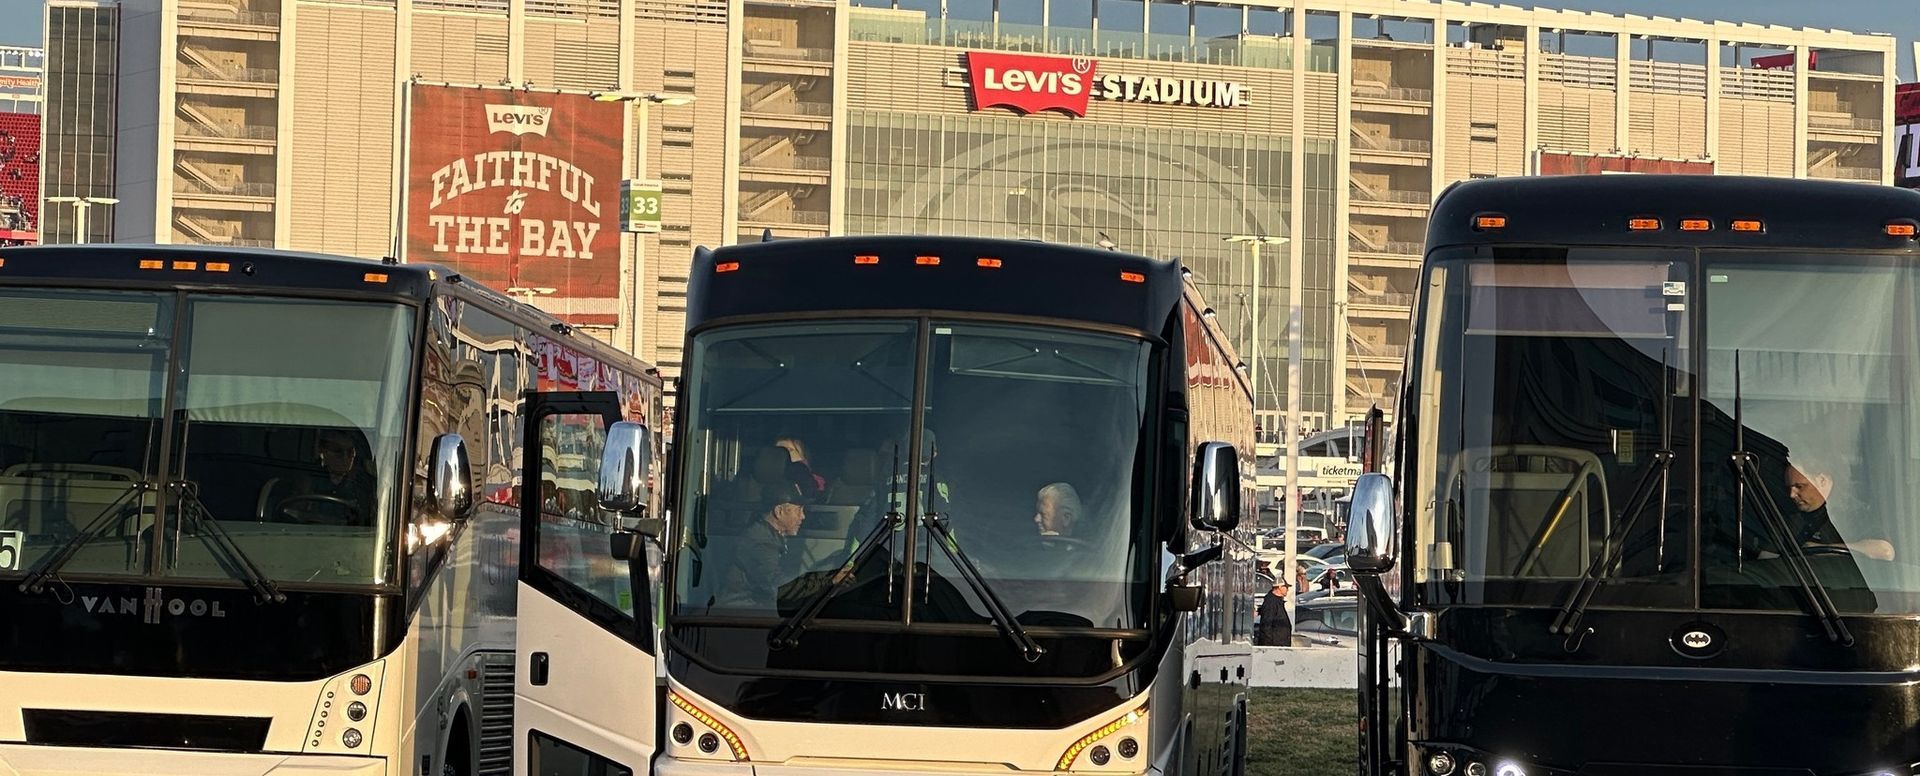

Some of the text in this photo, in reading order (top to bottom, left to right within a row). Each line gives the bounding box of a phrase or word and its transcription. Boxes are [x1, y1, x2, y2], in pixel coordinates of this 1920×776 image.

[1102, 73, 1241, 107] STADIUM
[429, 151, 600, 218] FAITHFUL
[503, 189, 528, 215] to
[633, 196, 658, 215] 33
[429, 215, 600, 260] THE BAY
[880, 692, 926, 711] MCI
